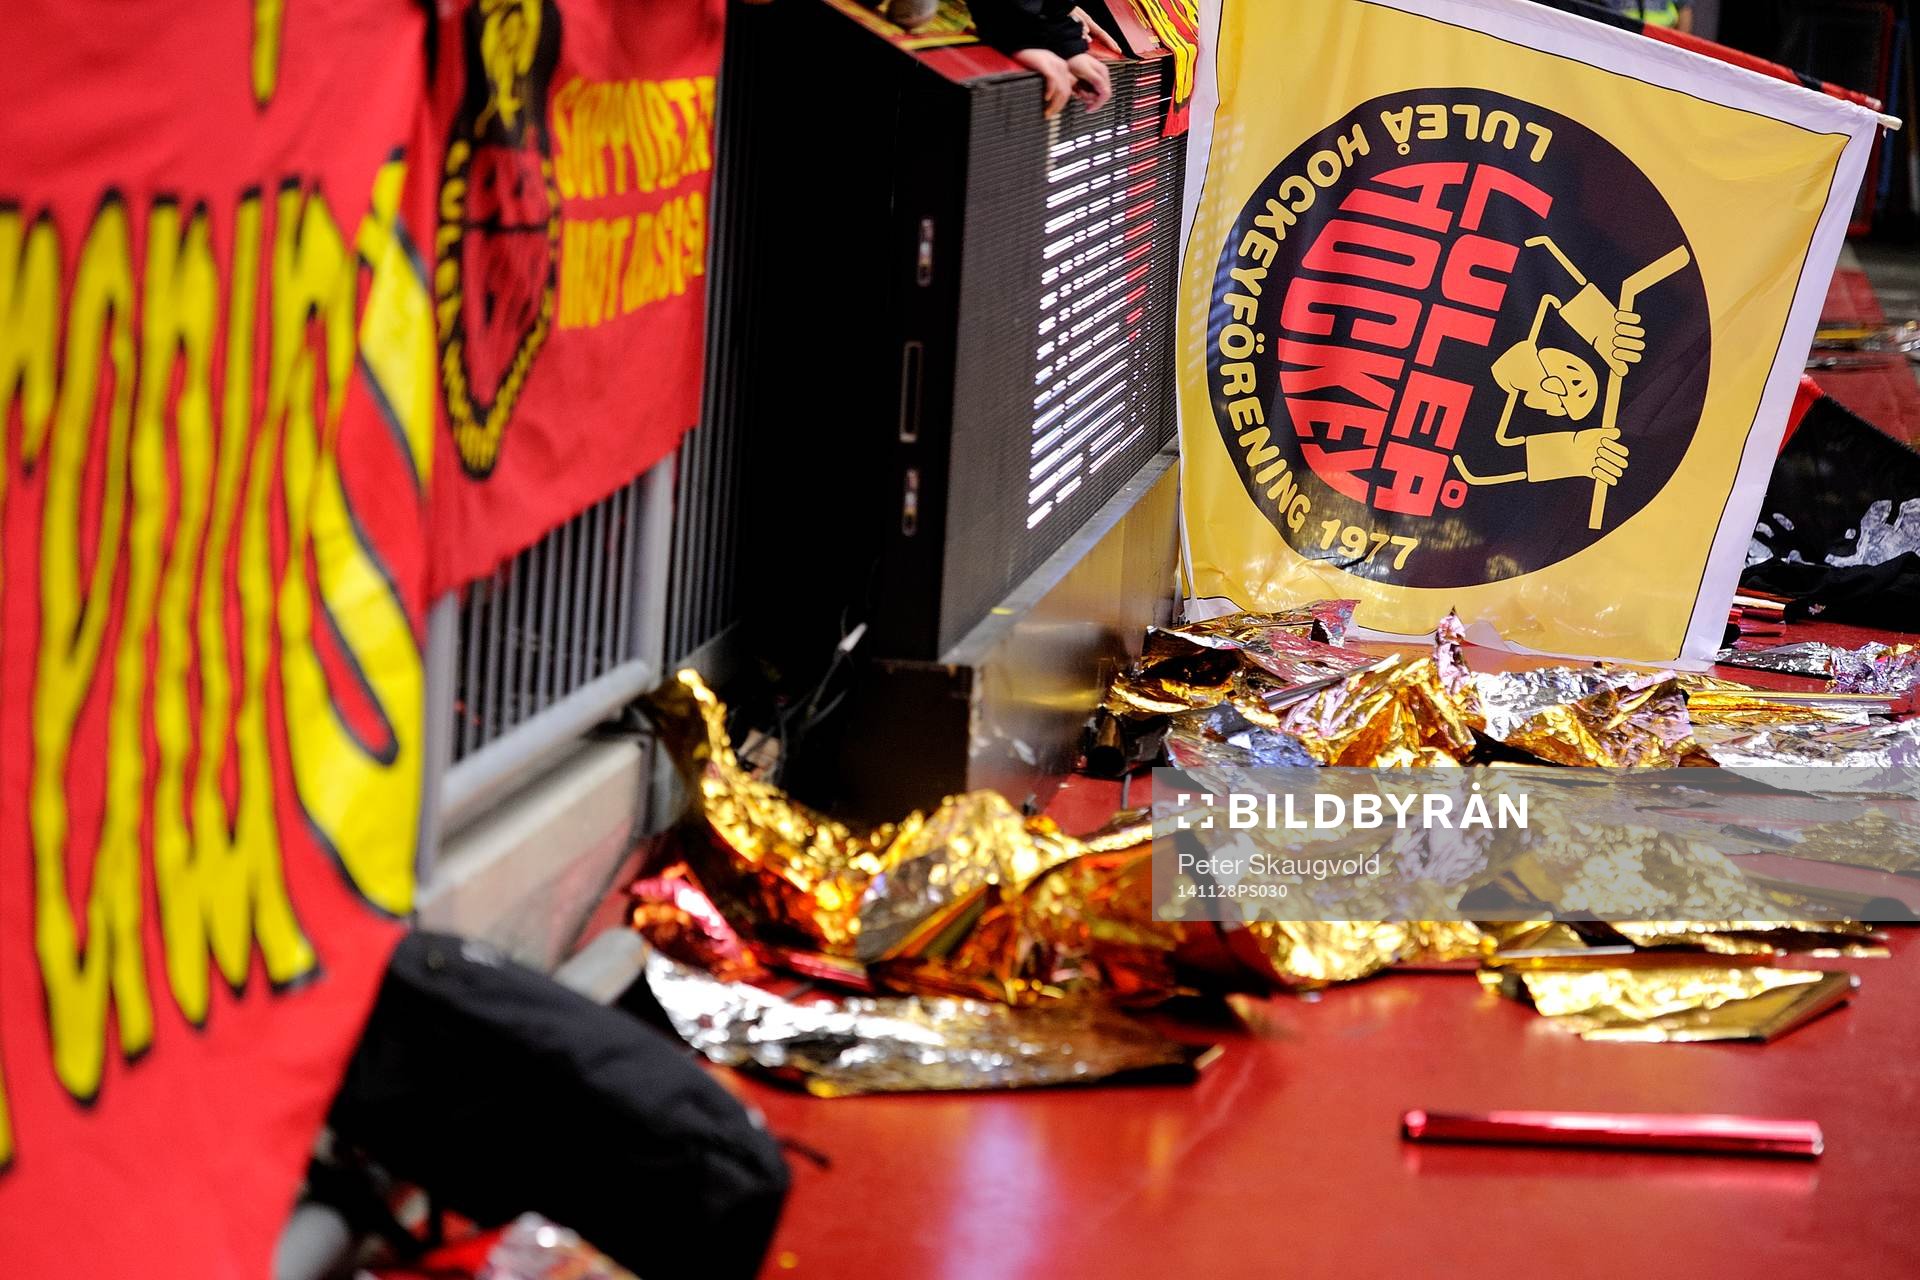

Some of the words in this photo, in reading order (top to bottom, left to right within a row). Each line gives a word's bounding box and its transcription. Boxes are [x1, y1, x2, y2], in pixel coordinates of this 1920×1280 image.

[1380, 103, 1553, 163] LULEÅ
[1218, 124, 1370, 533] HOCKEYFÖRENING
[1277, 161, 1470, 505] HOCKEY
[1373, 163, 1553, 517] LULEÅ
[1320, 519, 1419, 571] 1977
